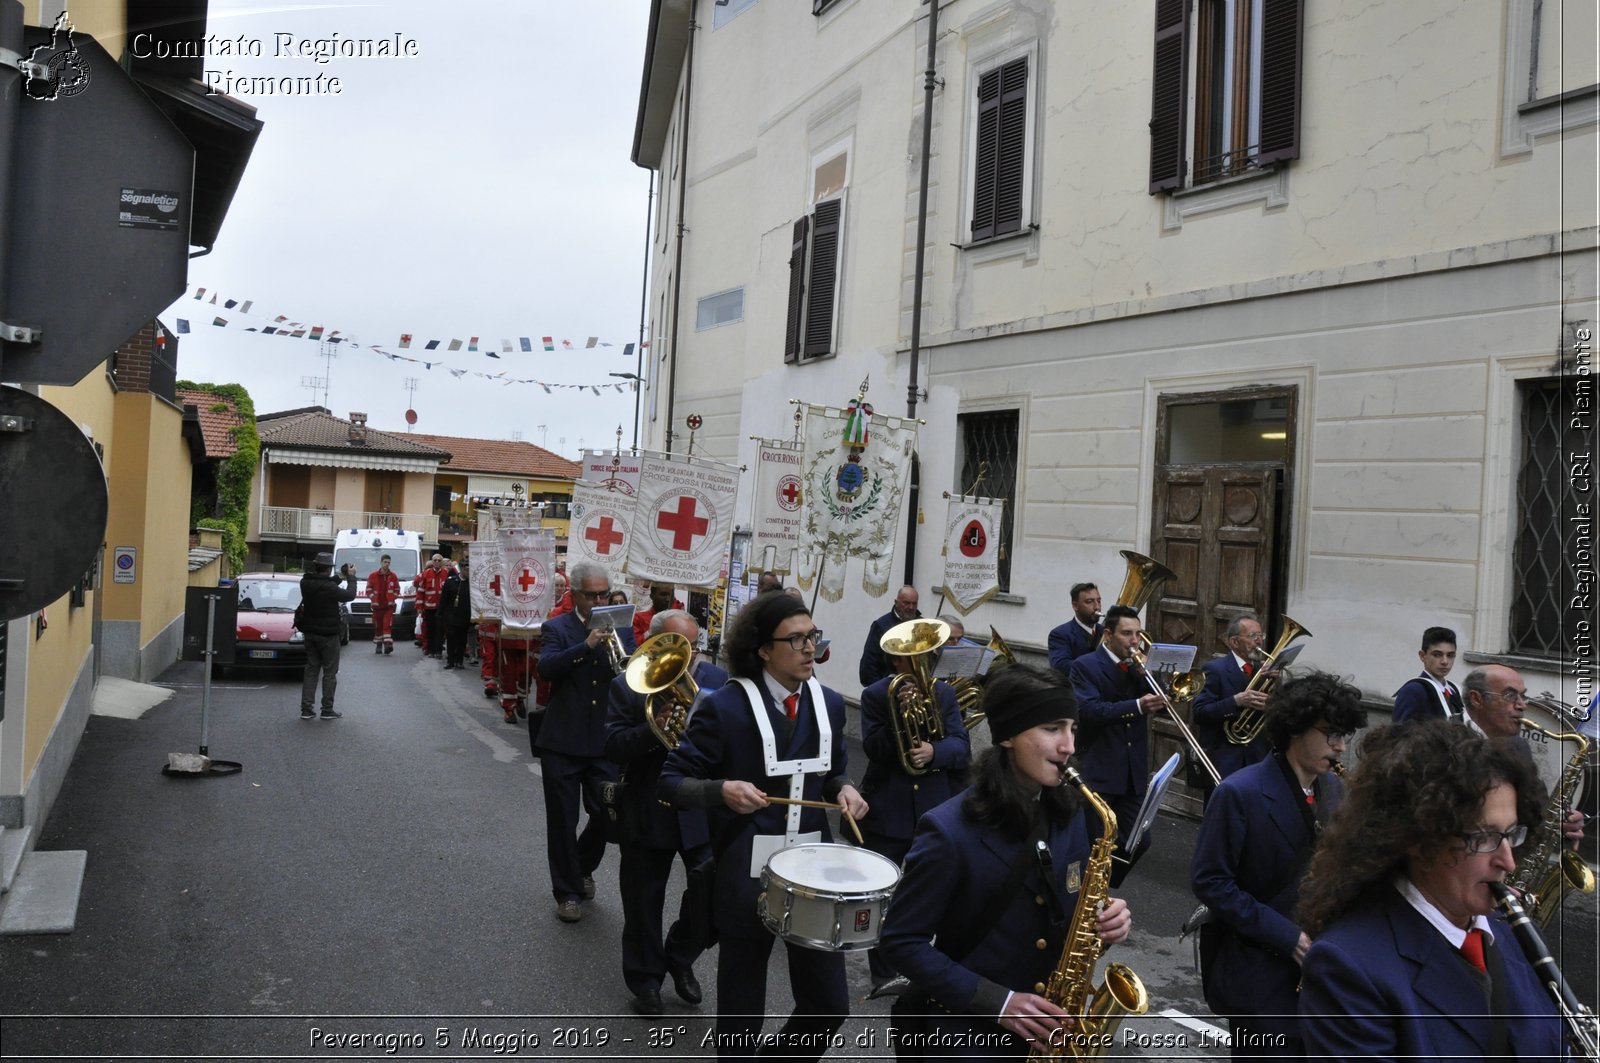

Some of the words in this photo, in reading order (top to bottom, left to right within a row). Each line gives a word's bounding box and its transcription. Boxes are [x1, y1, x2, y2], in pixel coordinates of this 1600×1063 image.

[121, 194, 178, 206] segnaletica
[762, 451, 782, 463] CROCE
[782, 454, 799, 466] ROSSA
[590, 464, 605, 472] CROCE
[605, 465, 619, 473] ROA
[642, 471, 670, 482] CROCE
[673, 476, 699, 487] ROSSA
[701, 482, 735, 494] ITALIANA
[596, 501, 617, 509] ROSSA
[765, 518, 791, 526] COMITATO
[645, 557, 698, 572] DELEGAZIONE
[646, 565, 704, 581] PEVERAGNO
[512, 609, 541, 619] MANTA
